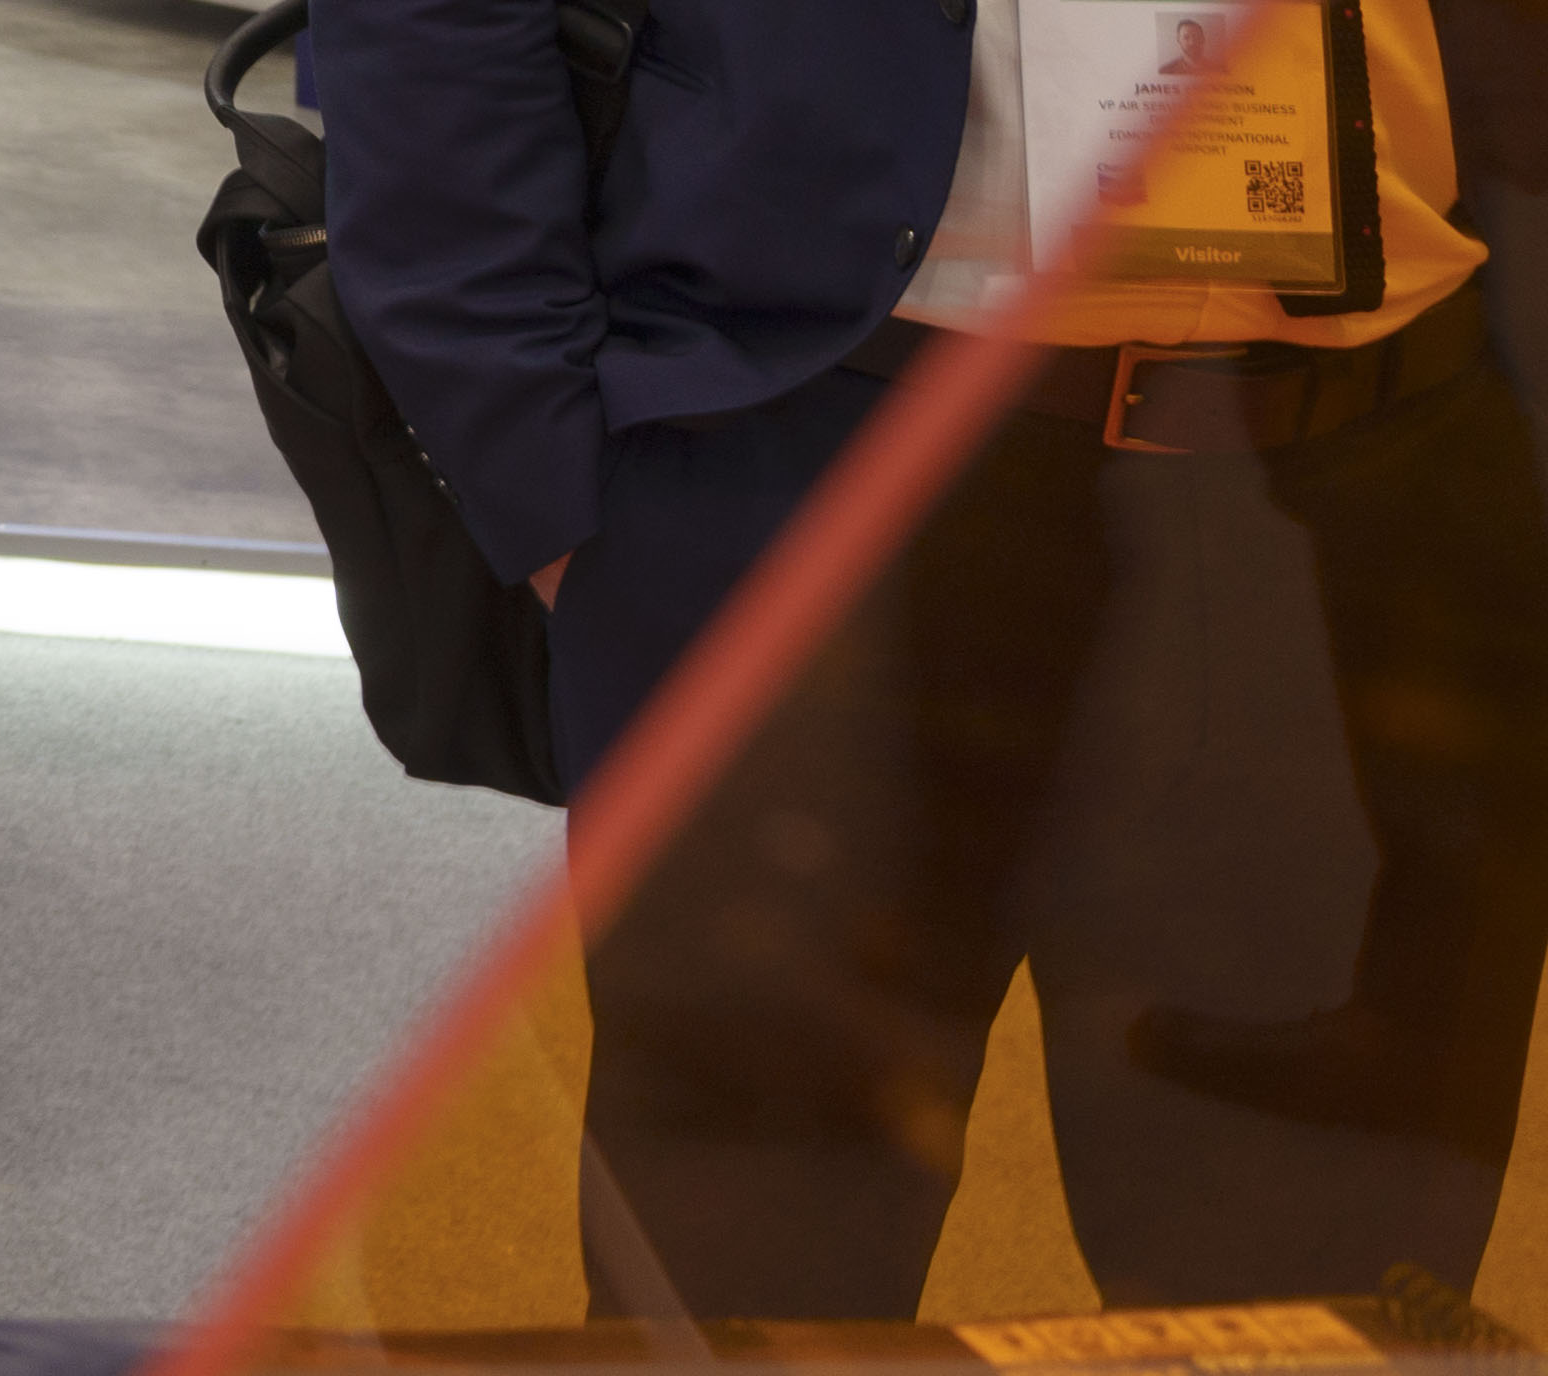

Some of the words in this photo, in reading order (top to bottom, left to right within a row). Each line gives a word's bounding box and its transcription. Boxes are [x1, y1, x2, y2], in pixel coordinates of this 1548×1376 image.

[1134, 83, 1181, 96] JAMES
[1098, 100, 1118, 112] VP
[1119, 100, 1139, 112] AIR
[1233, 103, 1297, 116] BUSINESS
[1175, 246, 1242, 264] Visitor
